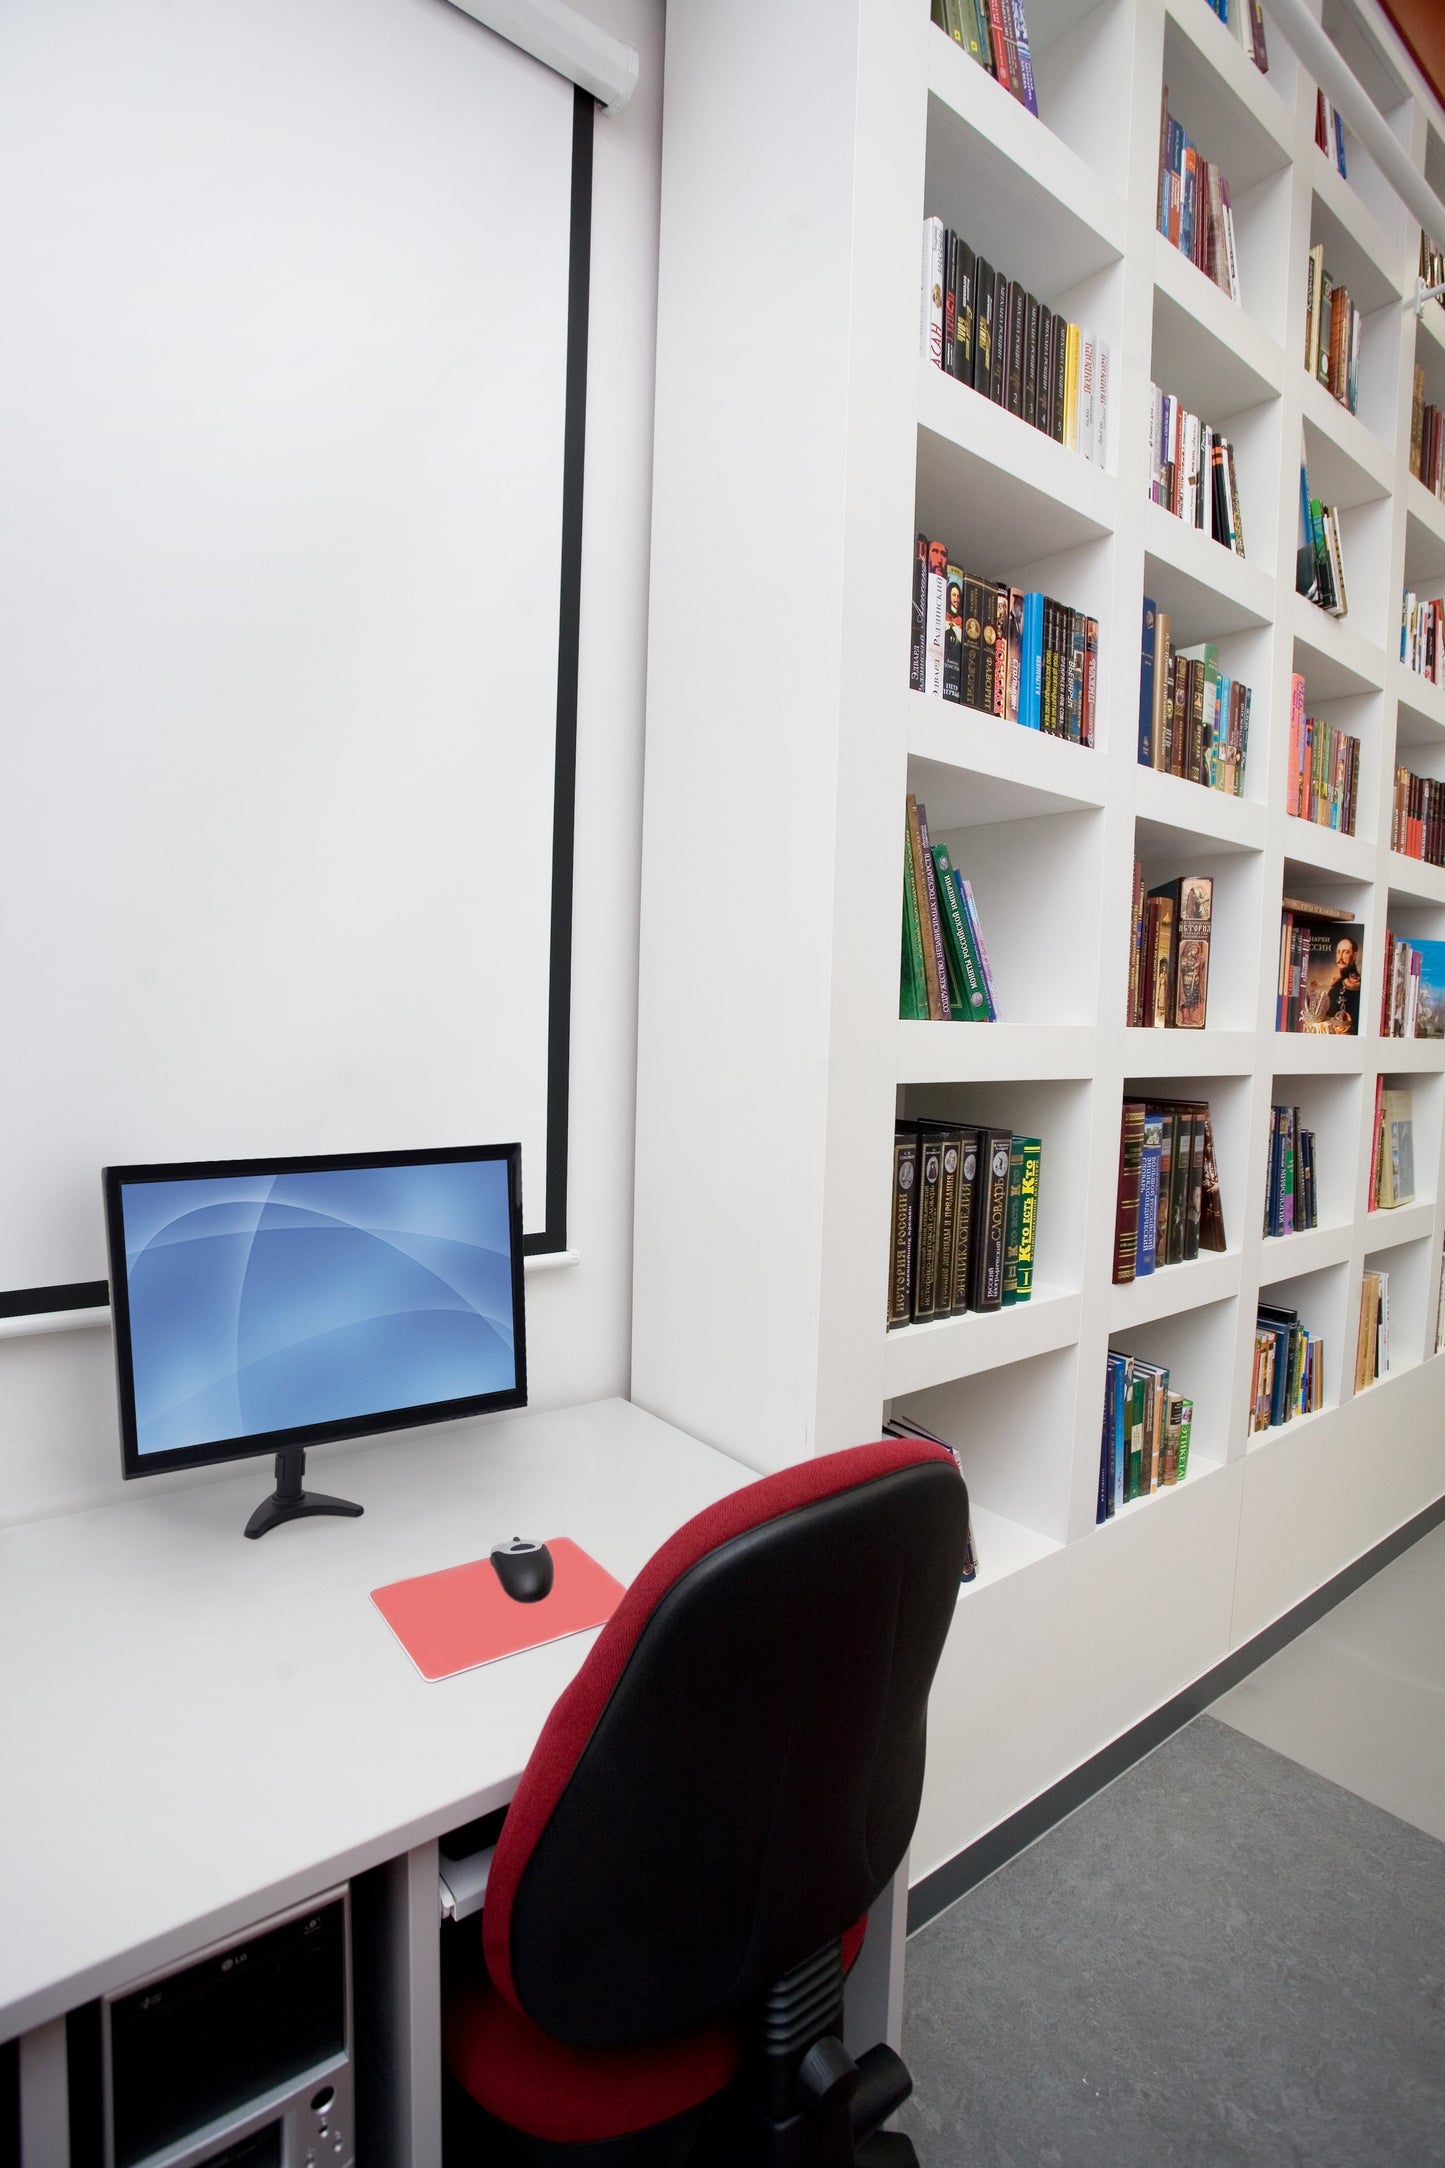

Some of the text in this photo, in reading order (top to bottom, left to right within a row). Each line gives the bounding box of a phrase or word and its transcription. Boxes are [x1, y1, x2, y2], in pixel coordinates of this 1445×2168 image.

[911, 645, 920, 680] ЭДВАРД
[984, 656, 992, 710] ФАВОРИТ
[924, 853, 936, 900] ГОСУДАРСТВ
[930, 902, 943, 958] НЕЗАВИСИМЫХ
[944, 874, 978, 989] МОНЕТЫ РОССИЙСКОЙ ИМПЕРИИ
[937, 960, 949, 1013] СОДРУЖЕСТВО
[991, 1178, 1004, 1241] СЛОВАРЬ
[1143, 1157, 1151, 1251] ЭНЦИКЛОПЕДИЧЕСКИЙ
[896, 1193, 908, 1311] ИСТОРИЯ РОССИИ
[956, 1183, 971, 1297] ЭНЦИКЛОПЕДИЯ
